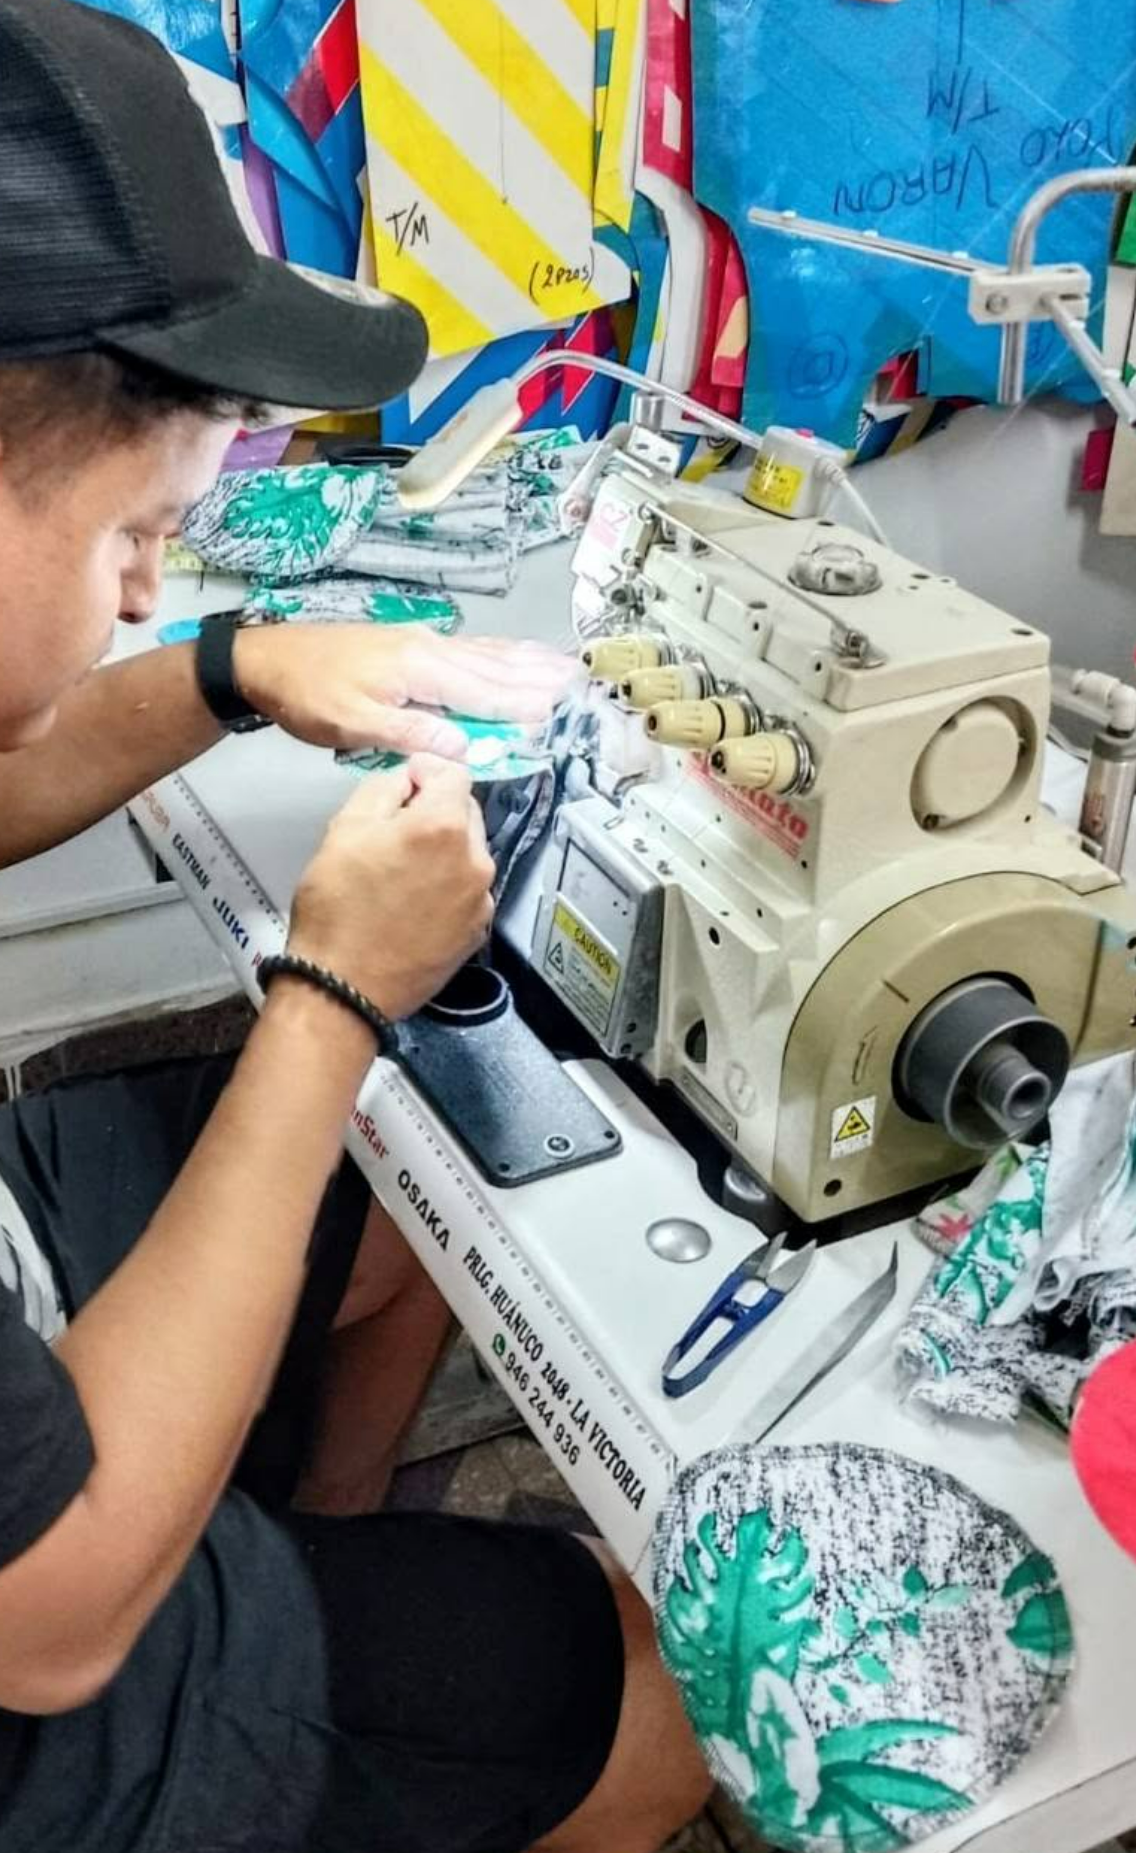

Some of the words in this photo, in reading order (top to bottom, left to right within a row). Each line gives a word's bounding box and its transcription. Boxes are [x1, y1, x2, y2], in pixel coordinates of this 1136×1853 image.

[834, 145, 997, 216] VARON
[385, 202, 430, 257] T/M
[172, 833, 211, 890] EASTMAN
[212, 897, 250, 949] JUKI
[574, 927, 613, 976] CAUTION
[351, 1109, 389, 1159] nStar
[398, 1169, 450, 1251] OSAKA
[490, 1284, 544, 1362] HUÁNUCO
[569, 1398, 590, 1433] LA
[588, 1421, 646, 1511] VICTORIA
[505, 1351, 531, 1392] 946
[528, 1386, 555, 1428] 244
[553, 1423, 580, 1466] 936
